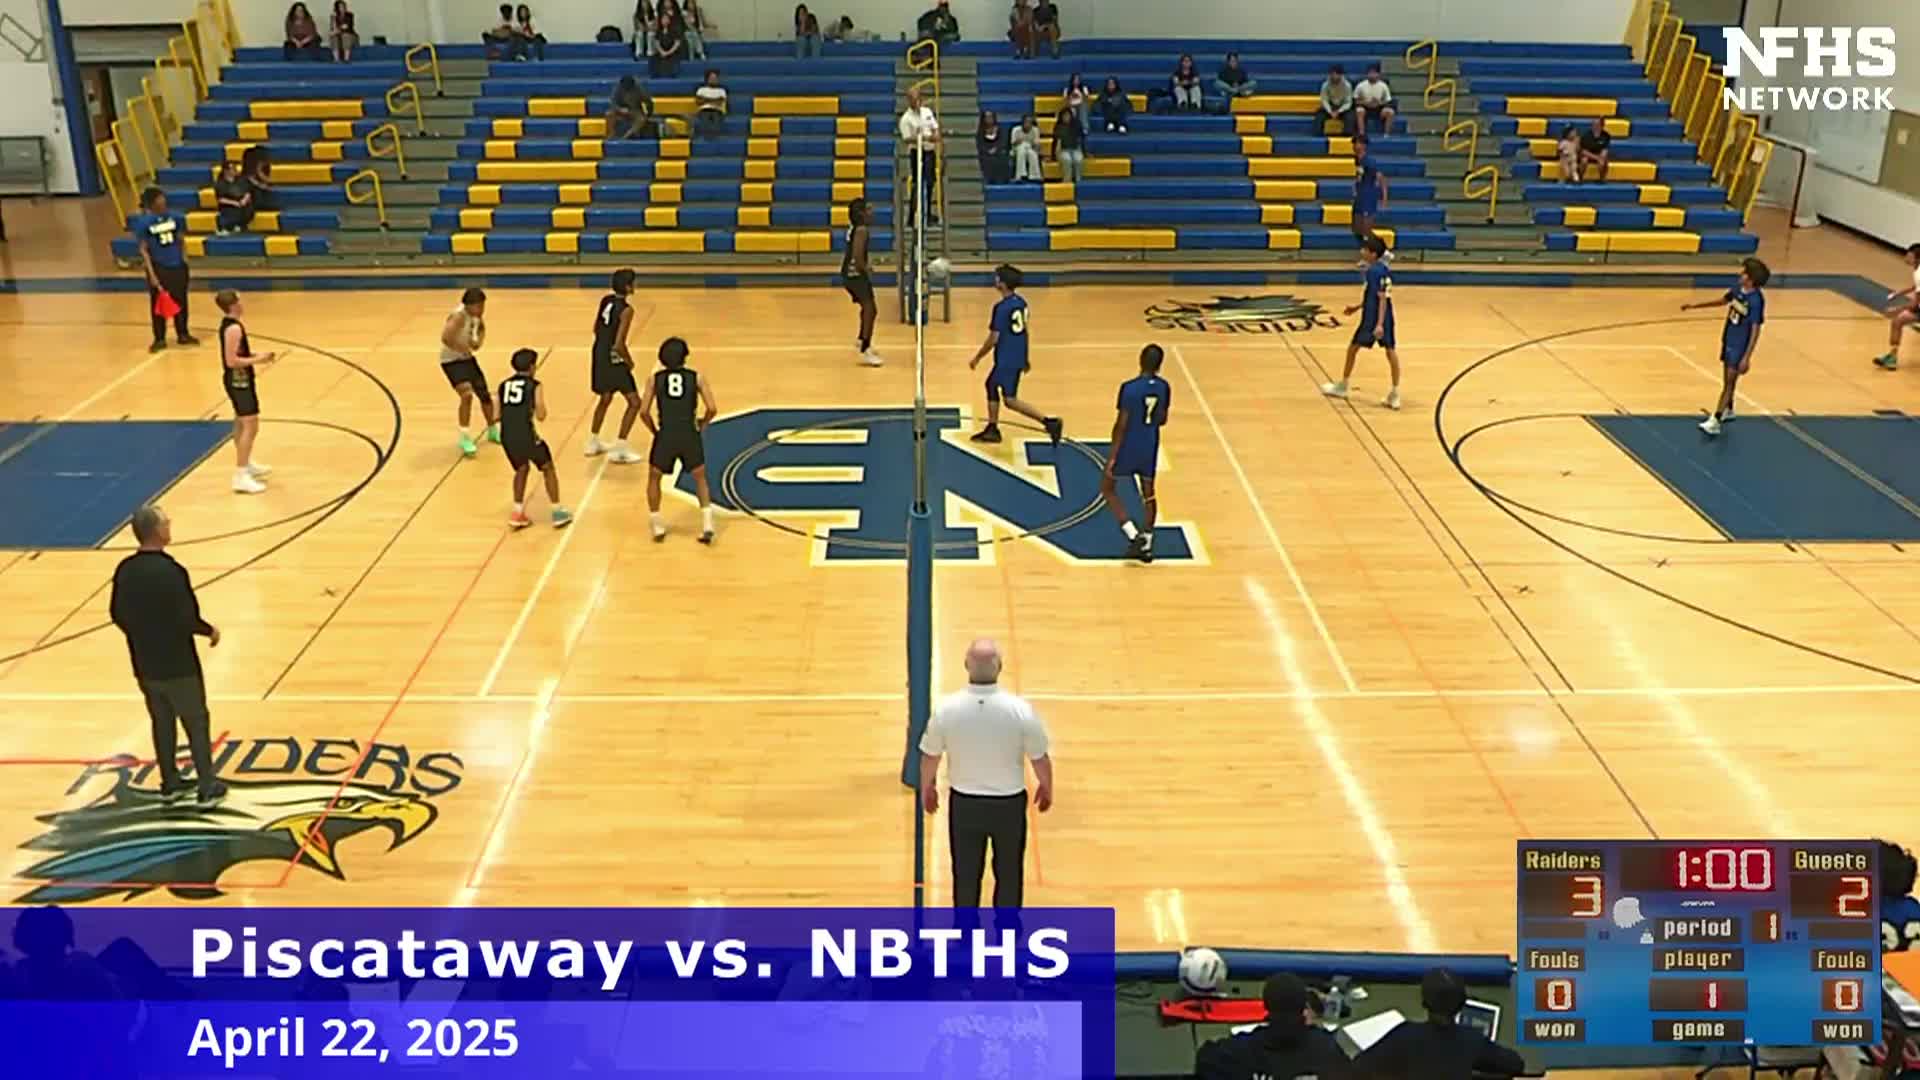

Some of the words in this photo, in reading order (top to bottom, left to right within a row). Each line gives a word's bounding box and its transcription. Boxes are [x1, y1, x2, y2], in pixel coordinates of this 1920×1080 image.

[601, 302, 614, 326] 4
[503, 380, 525, 404] 15
[667, 372, 684, 398] 8
[1144, 396, 1159, 425] 7
